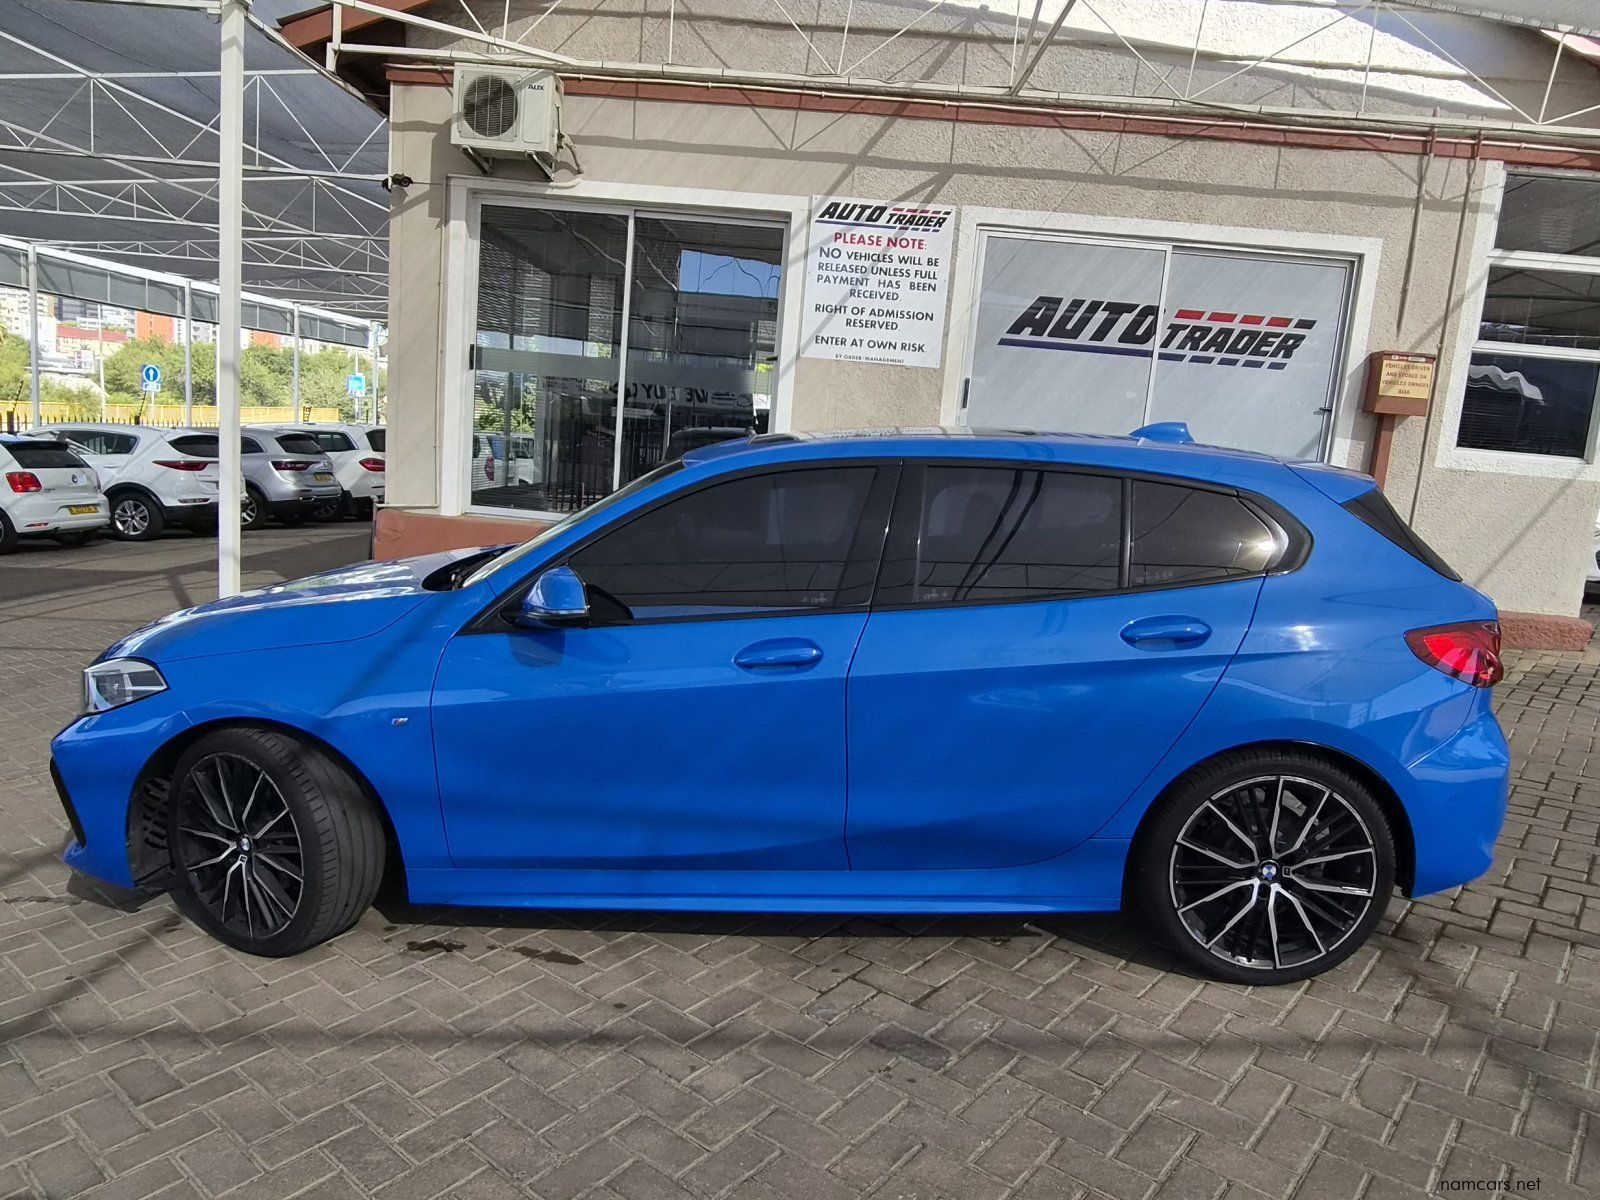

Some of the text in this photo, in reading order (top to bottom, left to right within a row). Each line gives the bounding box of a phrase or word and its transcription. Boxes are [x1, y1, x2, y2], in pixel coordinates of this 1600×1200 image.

[818, 202, 948, 228] AUTO TRADER
[834, 232, 927, 250] PLEASE NOTE:
[819, 247, 939, 267] NO VEHICLES WILL BE
[818, 262, 938, 280] RELEASED UNLESS FULL
[817, 275, 937, 292] PAYMENT HAS BEEN
[815, 304, 934, 321] RIGHT OF ADMISSION
[1005, 296, 1306, 360] AUTO TRADER
[815, 335, 847, 346] ENTER
[851, 338, 863, 347] AT
[867, 340, 897, 350] OWN
